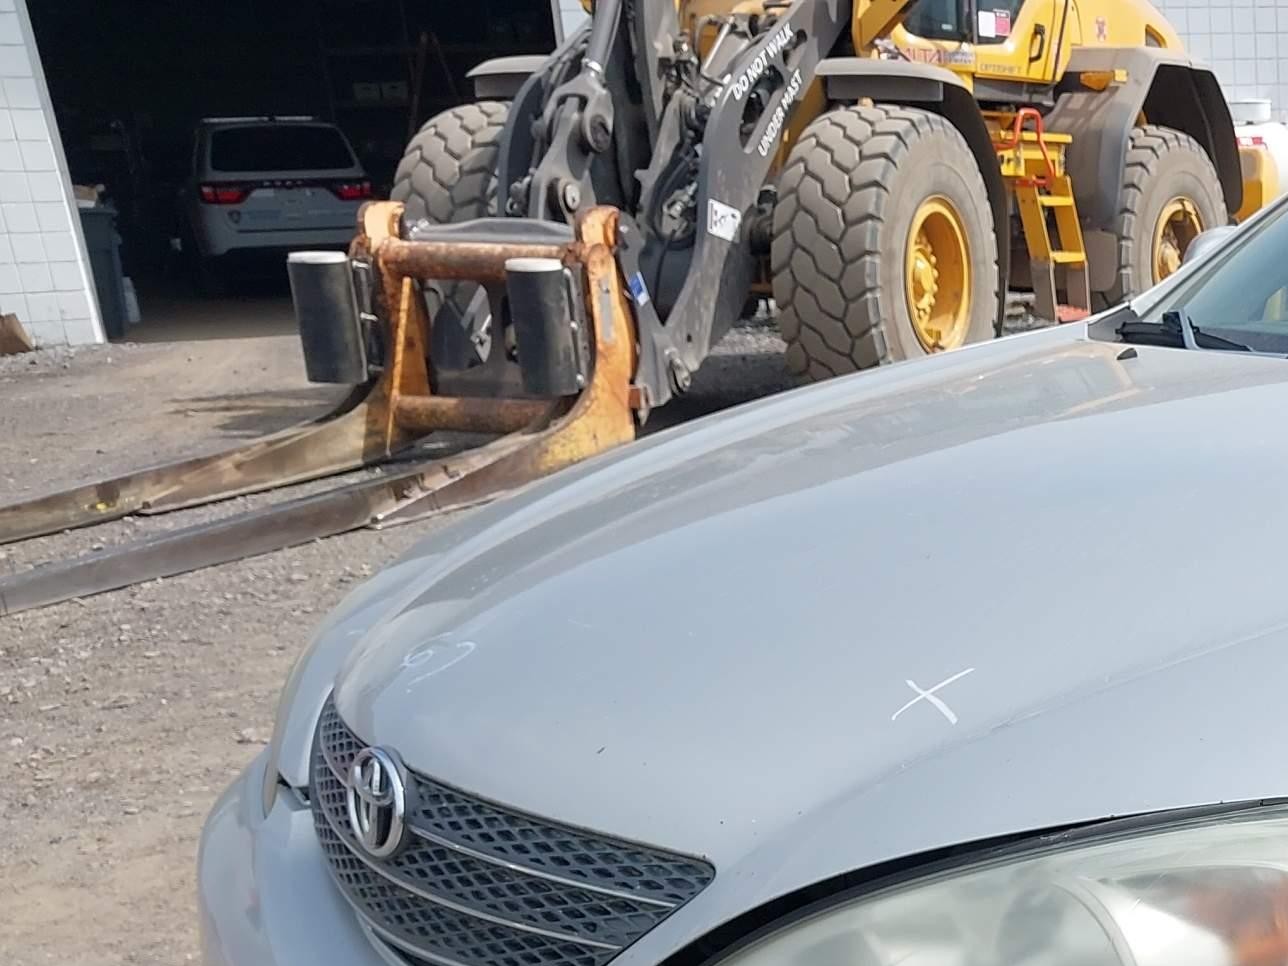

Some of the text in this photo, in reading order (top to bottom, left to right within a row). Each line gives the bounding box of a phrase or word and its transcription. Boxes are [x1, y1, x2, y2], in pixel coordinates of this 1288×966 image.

[732, 22, 794, 101] DO NOT WALK
[758, 68, 803, 157] UNDER MAST
